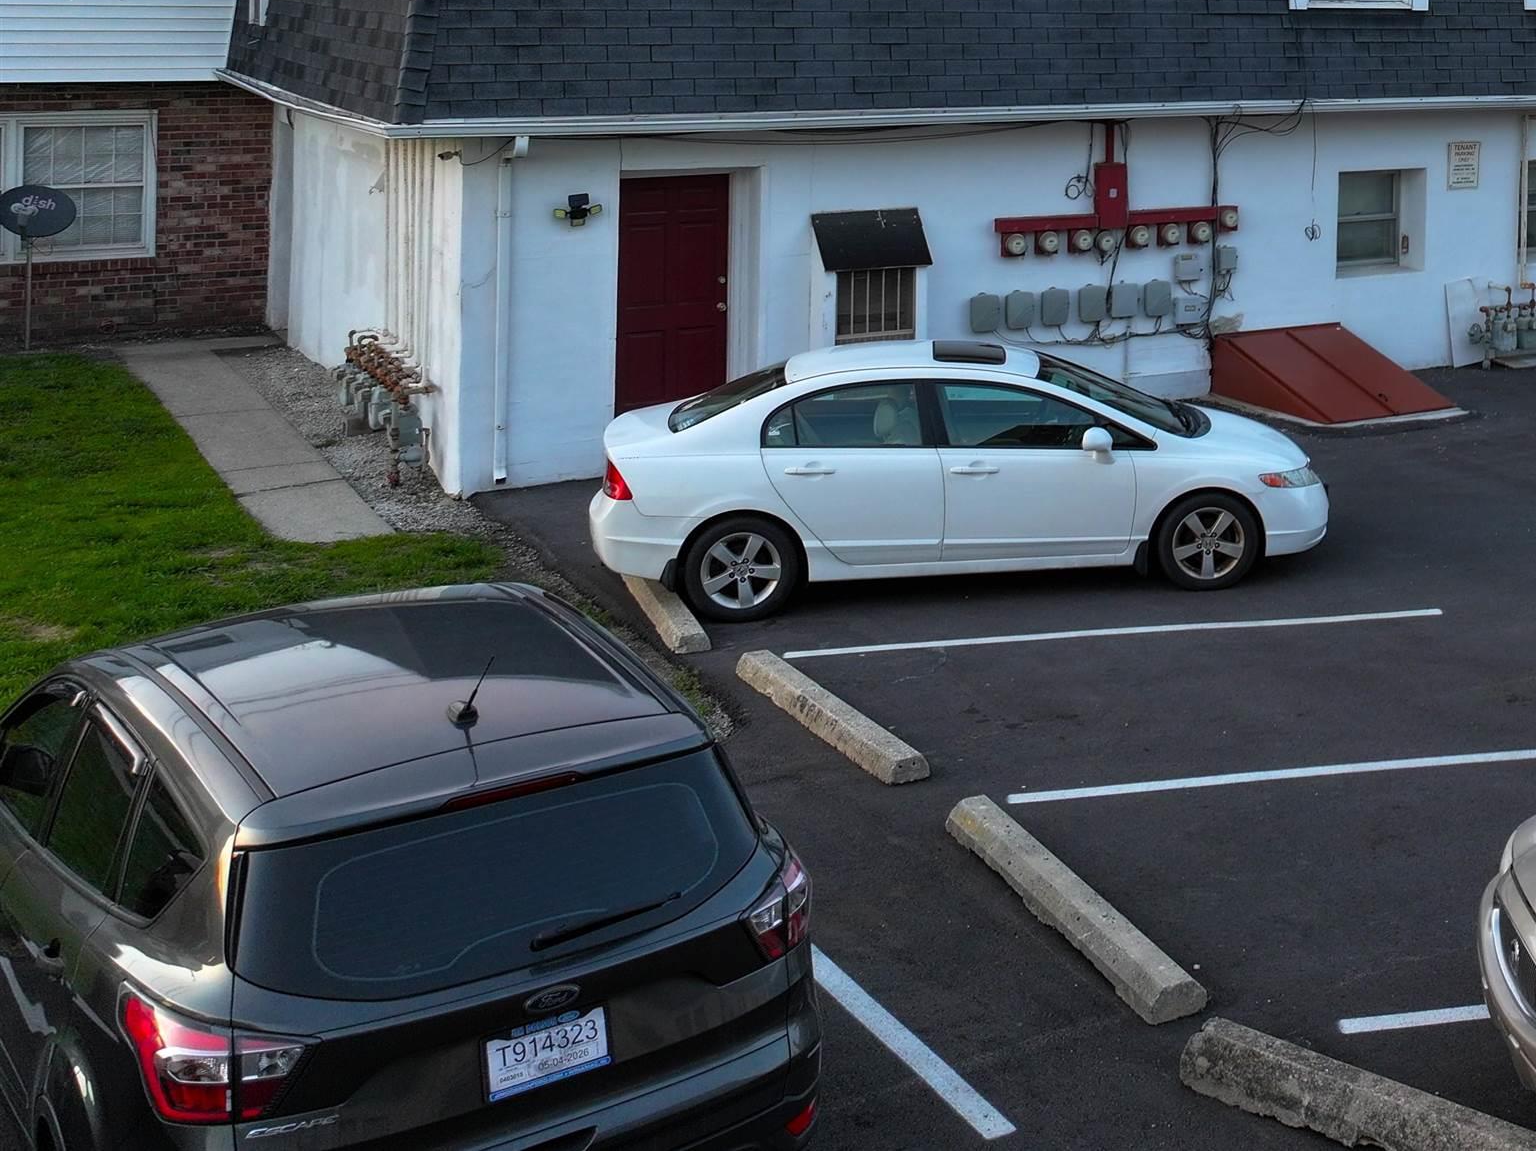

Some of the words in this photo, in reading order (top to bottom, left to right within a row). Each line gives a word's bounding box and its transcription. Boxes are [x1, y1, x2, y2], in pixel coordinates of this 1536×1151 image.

[22, 195, 56, 210] dish
[496, 1019, 598, 1067] T914323
[537, 1047, 590, 1072] 05-04-2026
[245, 1114, 339, 1139] ESCAPE
